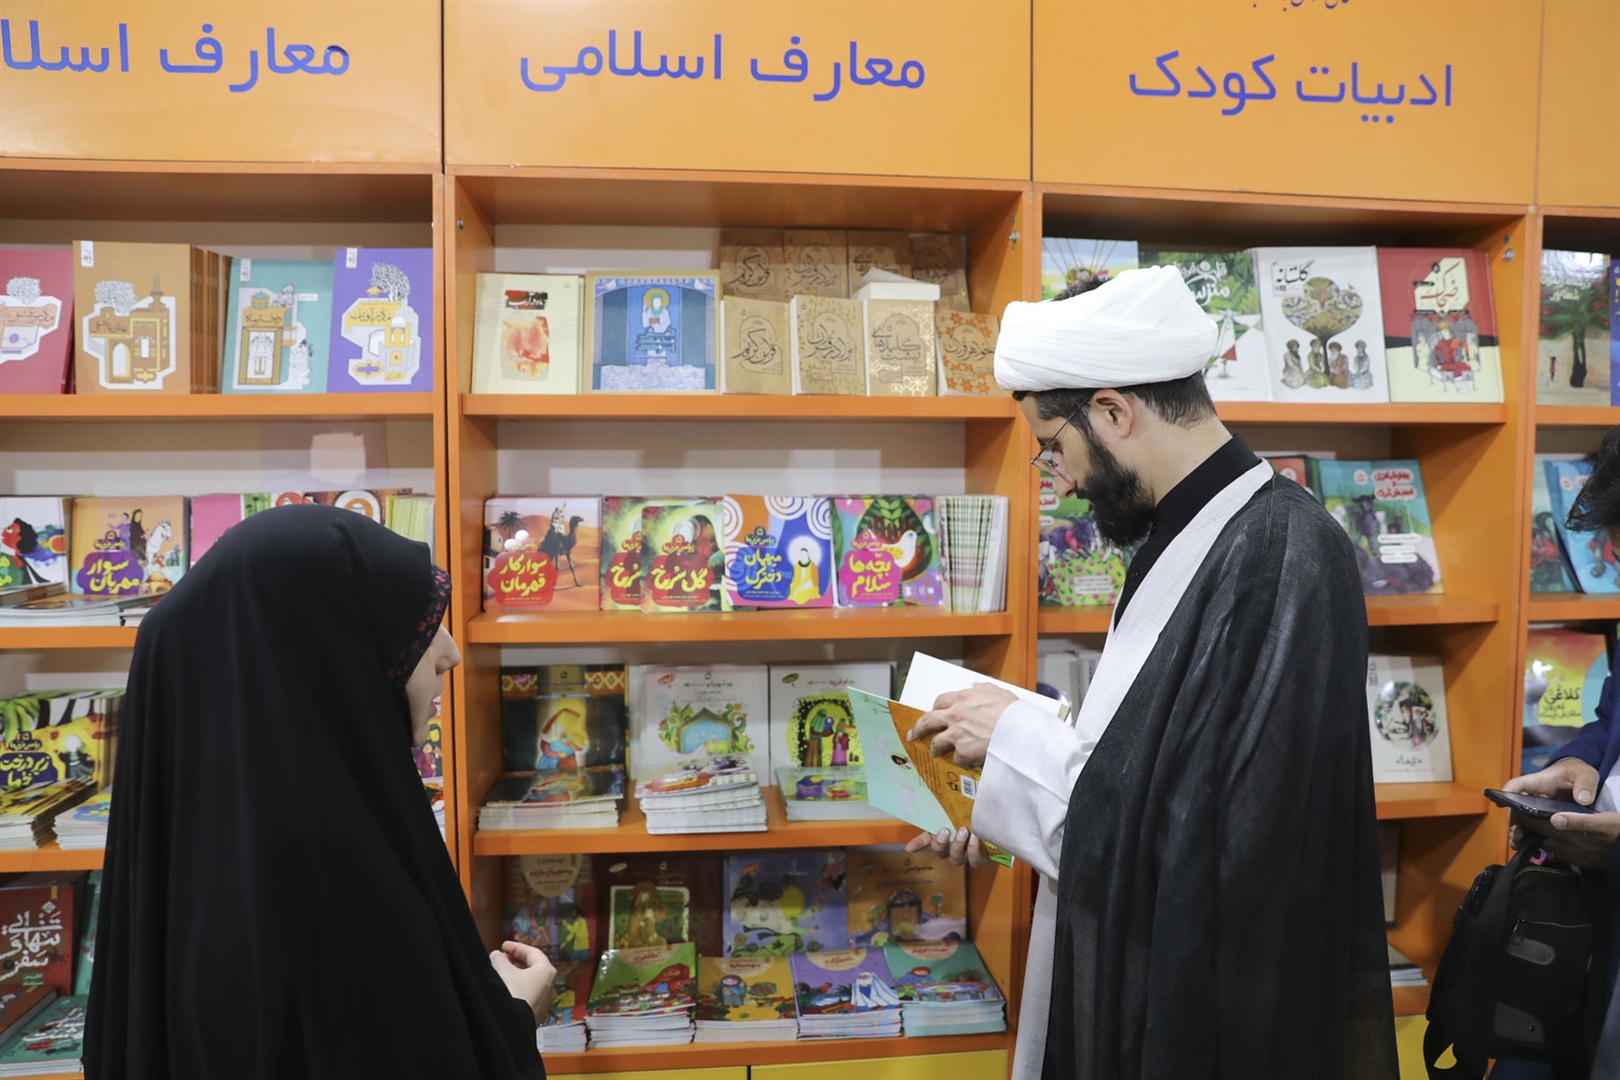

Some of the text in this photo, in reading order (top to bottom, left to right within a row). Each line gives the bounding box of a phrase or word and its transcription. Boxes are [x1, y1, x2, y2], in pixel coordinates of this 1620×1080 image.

[0, 18, 350, 93] معارف اسلا
[520, 29, 925, 102] معارف اسلامی
[1129, 49, 1452, 125] ادبیات کودک
[86, 559, 130, 576] سوار
[498, 553, 548, 575] سوارکار
[90, 572, 140, 595] مهربان
[500, 573, 547, 597] قهرمان
[681, 567, 709, 592] گل
[745, 565, 783, 590] دخترک
[851, 575, 892, 598] سلام
